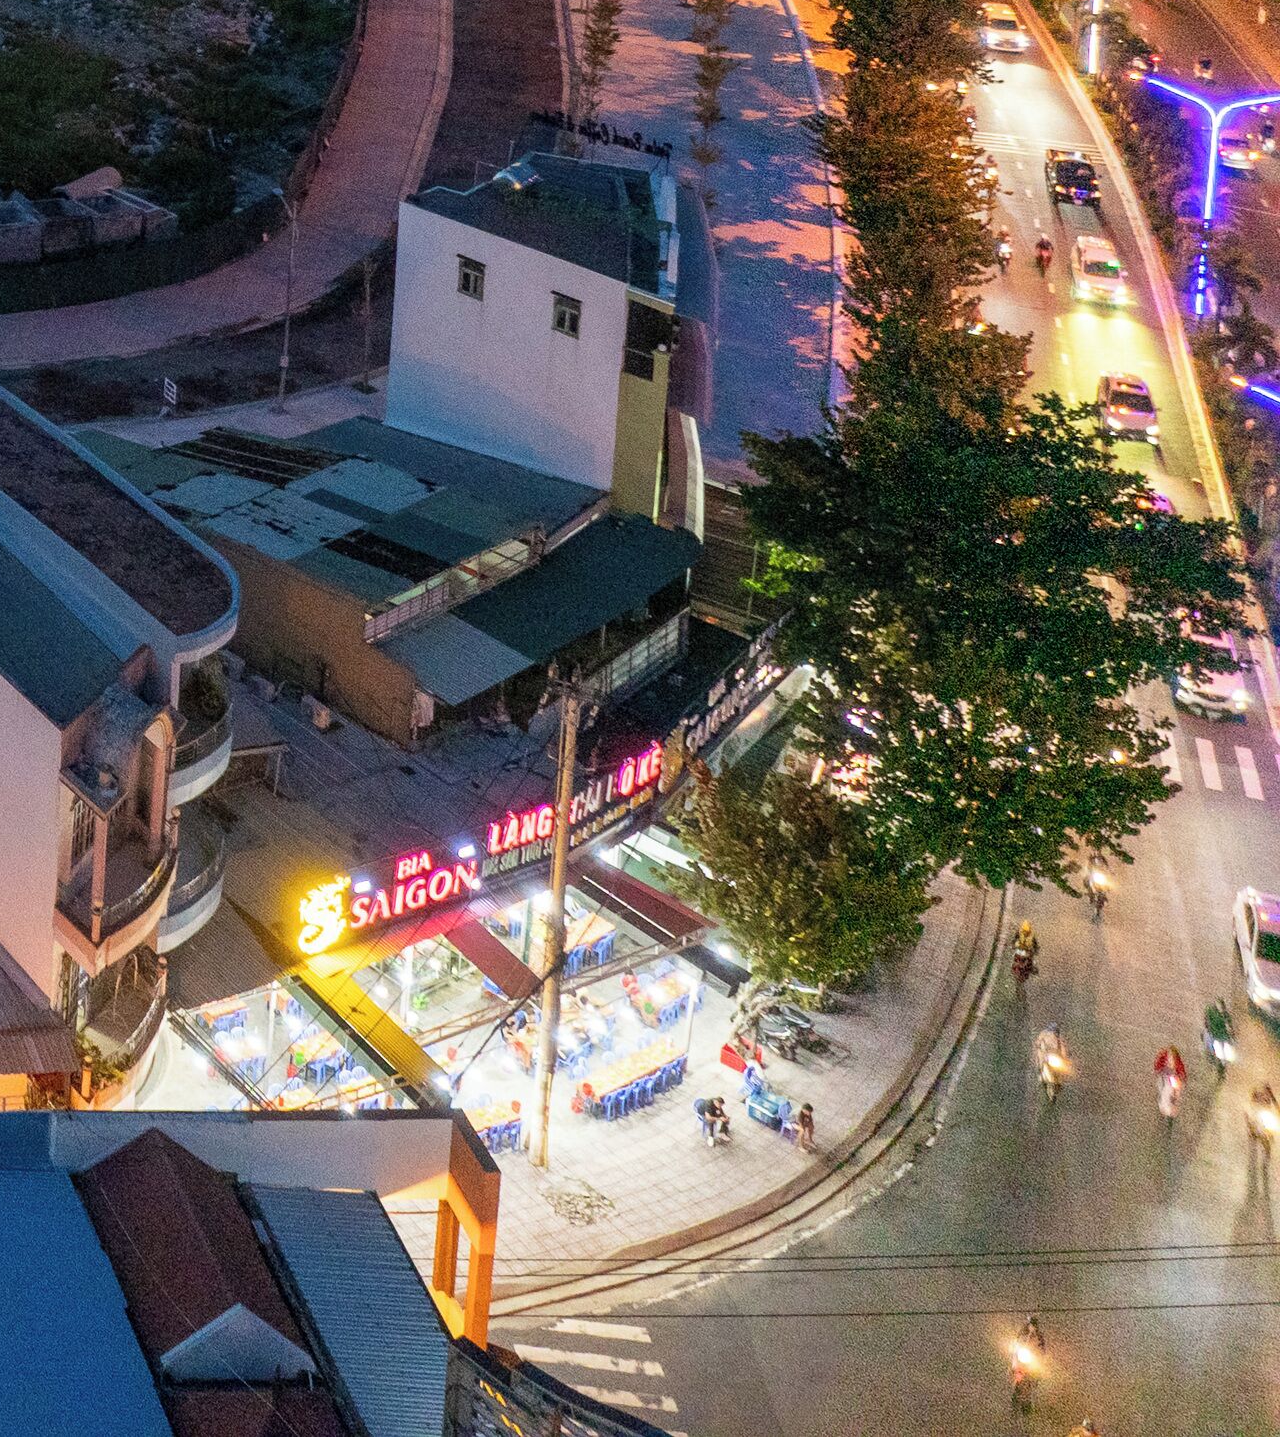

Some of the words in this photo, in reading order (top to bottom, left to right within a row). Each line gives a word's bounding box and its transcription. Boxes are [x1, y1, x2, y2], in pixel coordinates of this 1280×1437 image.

[487, 803, 556, 855] LÀNG
[396, 849, 432, 880] BIA
[350, 859, 478, 930] SAIGON
